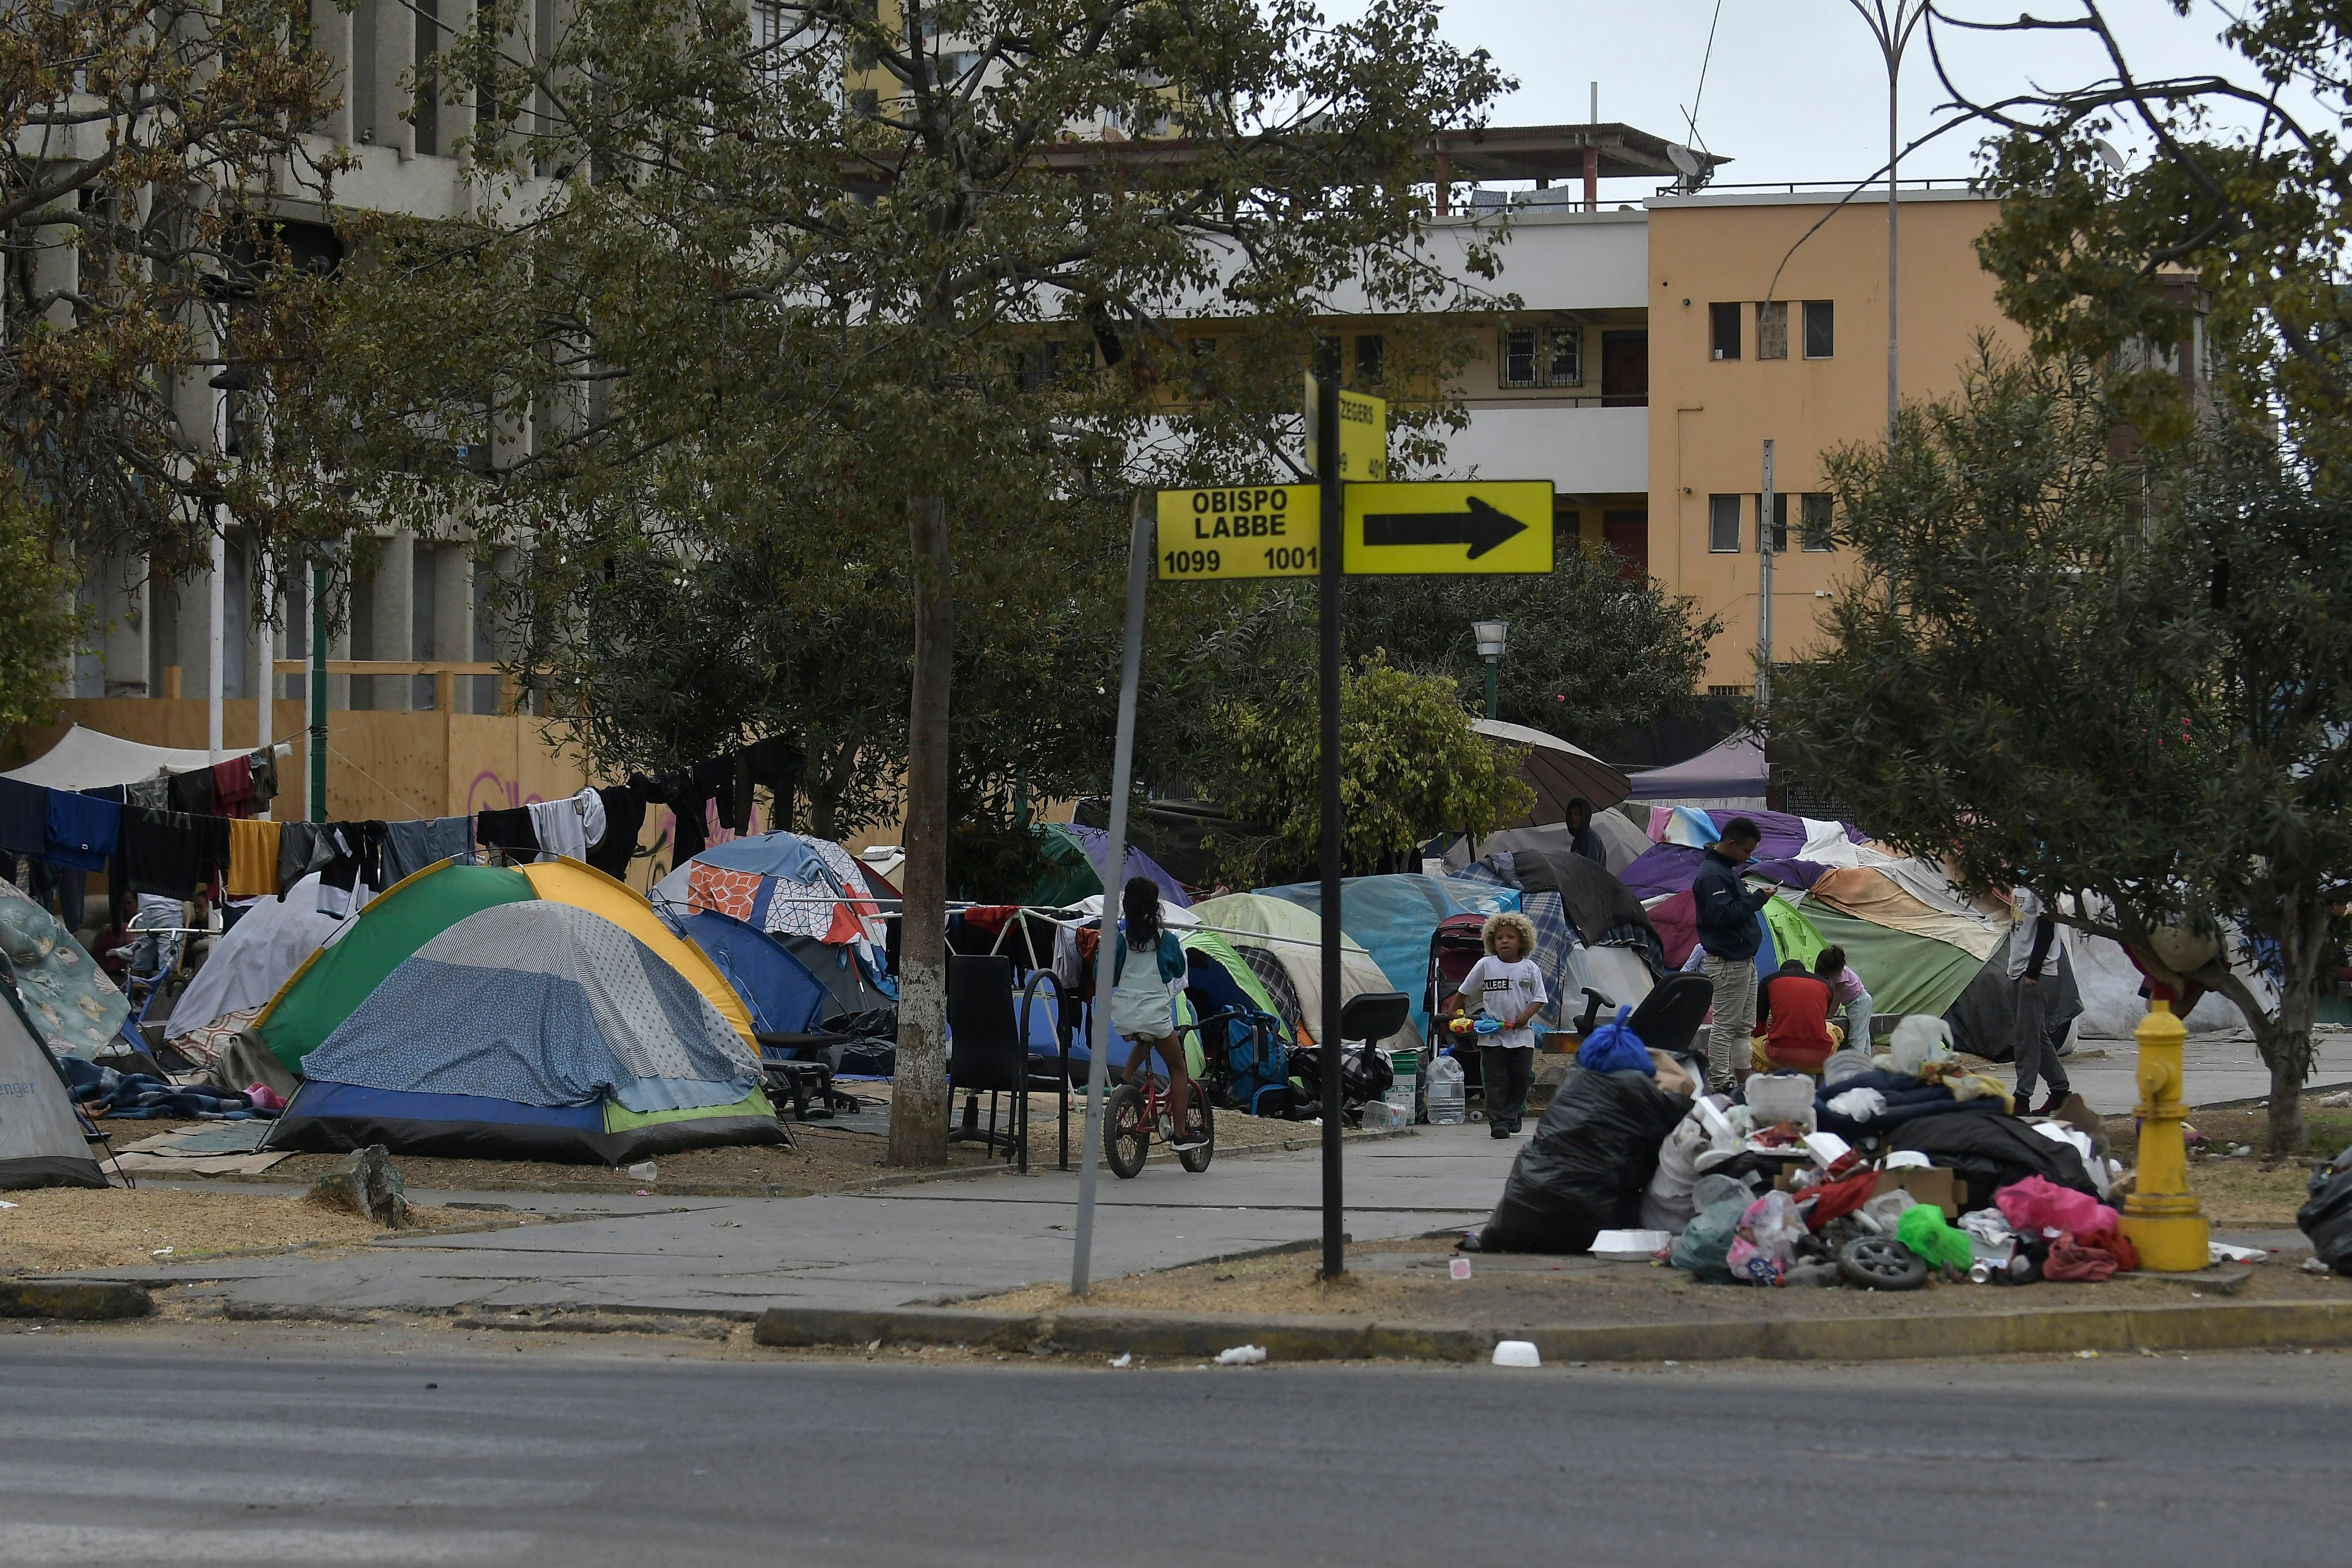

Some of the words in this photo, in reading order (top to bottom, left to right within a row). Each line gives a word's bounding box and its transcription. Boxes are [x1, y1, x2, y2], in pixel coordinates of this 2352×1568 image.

[1192, 489, 1287, 513] OBISPO
[1195, 514, 1285, 539] LABBE
[1164, 550, 1220, 573] 1099
[1264, 547, 1317, 570] 1001
